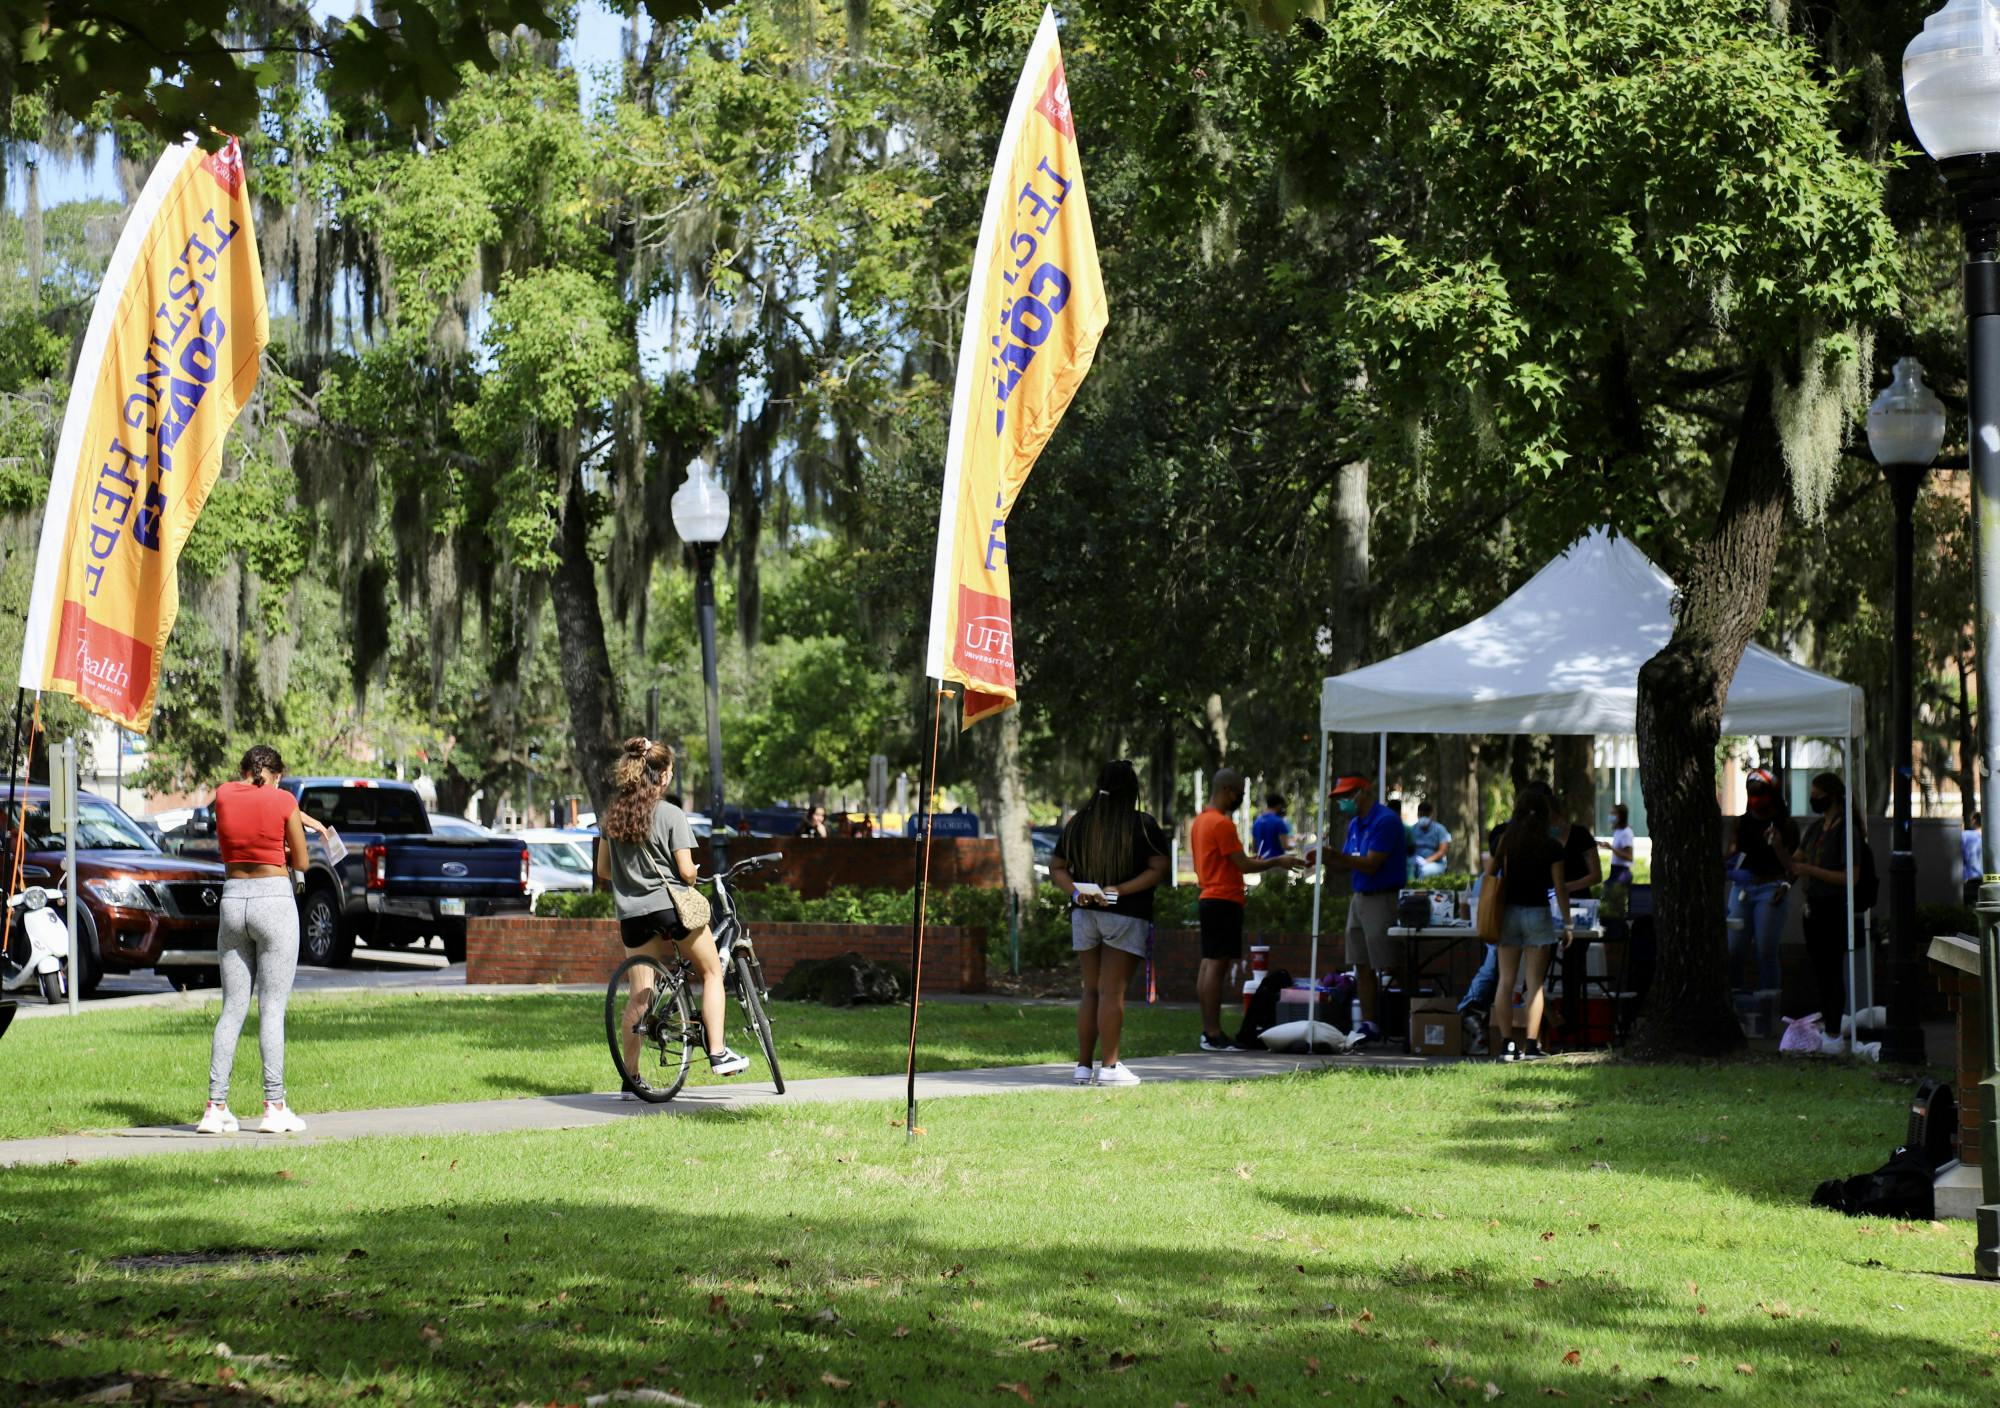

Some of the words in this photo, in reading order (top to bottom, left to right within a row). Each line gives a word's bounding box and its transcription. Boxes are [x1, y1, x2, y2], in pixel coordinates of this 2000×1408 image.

[123, 208, 240, 437] TESTING
[964, 650, 1005, 666] UNIVERSITY
[97, 682, 123, 697] HEALTH
